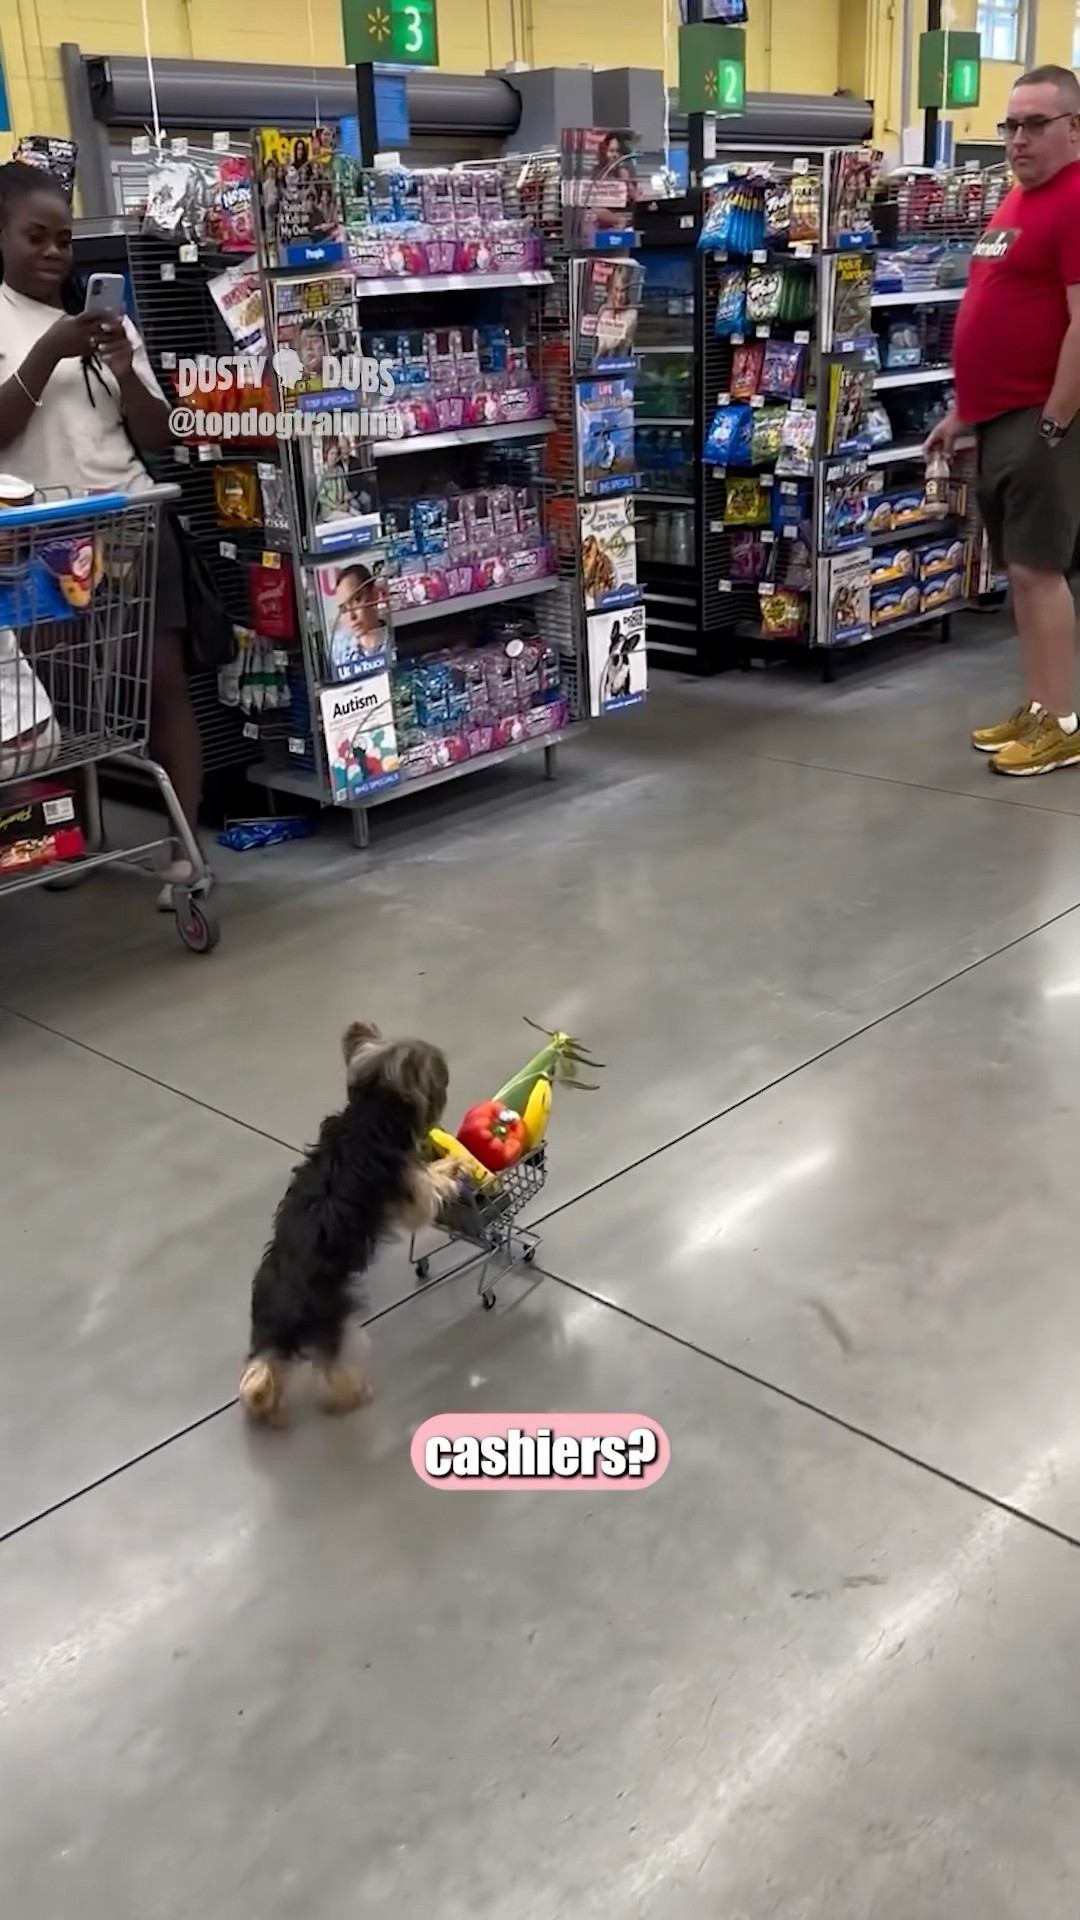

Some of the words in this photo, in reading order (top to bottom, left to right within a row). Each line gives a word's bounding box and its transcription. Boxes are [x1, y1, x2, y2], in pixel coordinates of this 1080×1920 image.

[404, 6, 423, 52] 3
[724, 66, 737, 102] 2
[963, 65, 971, 96] 1
[332, 693, 379, 719] Autism
